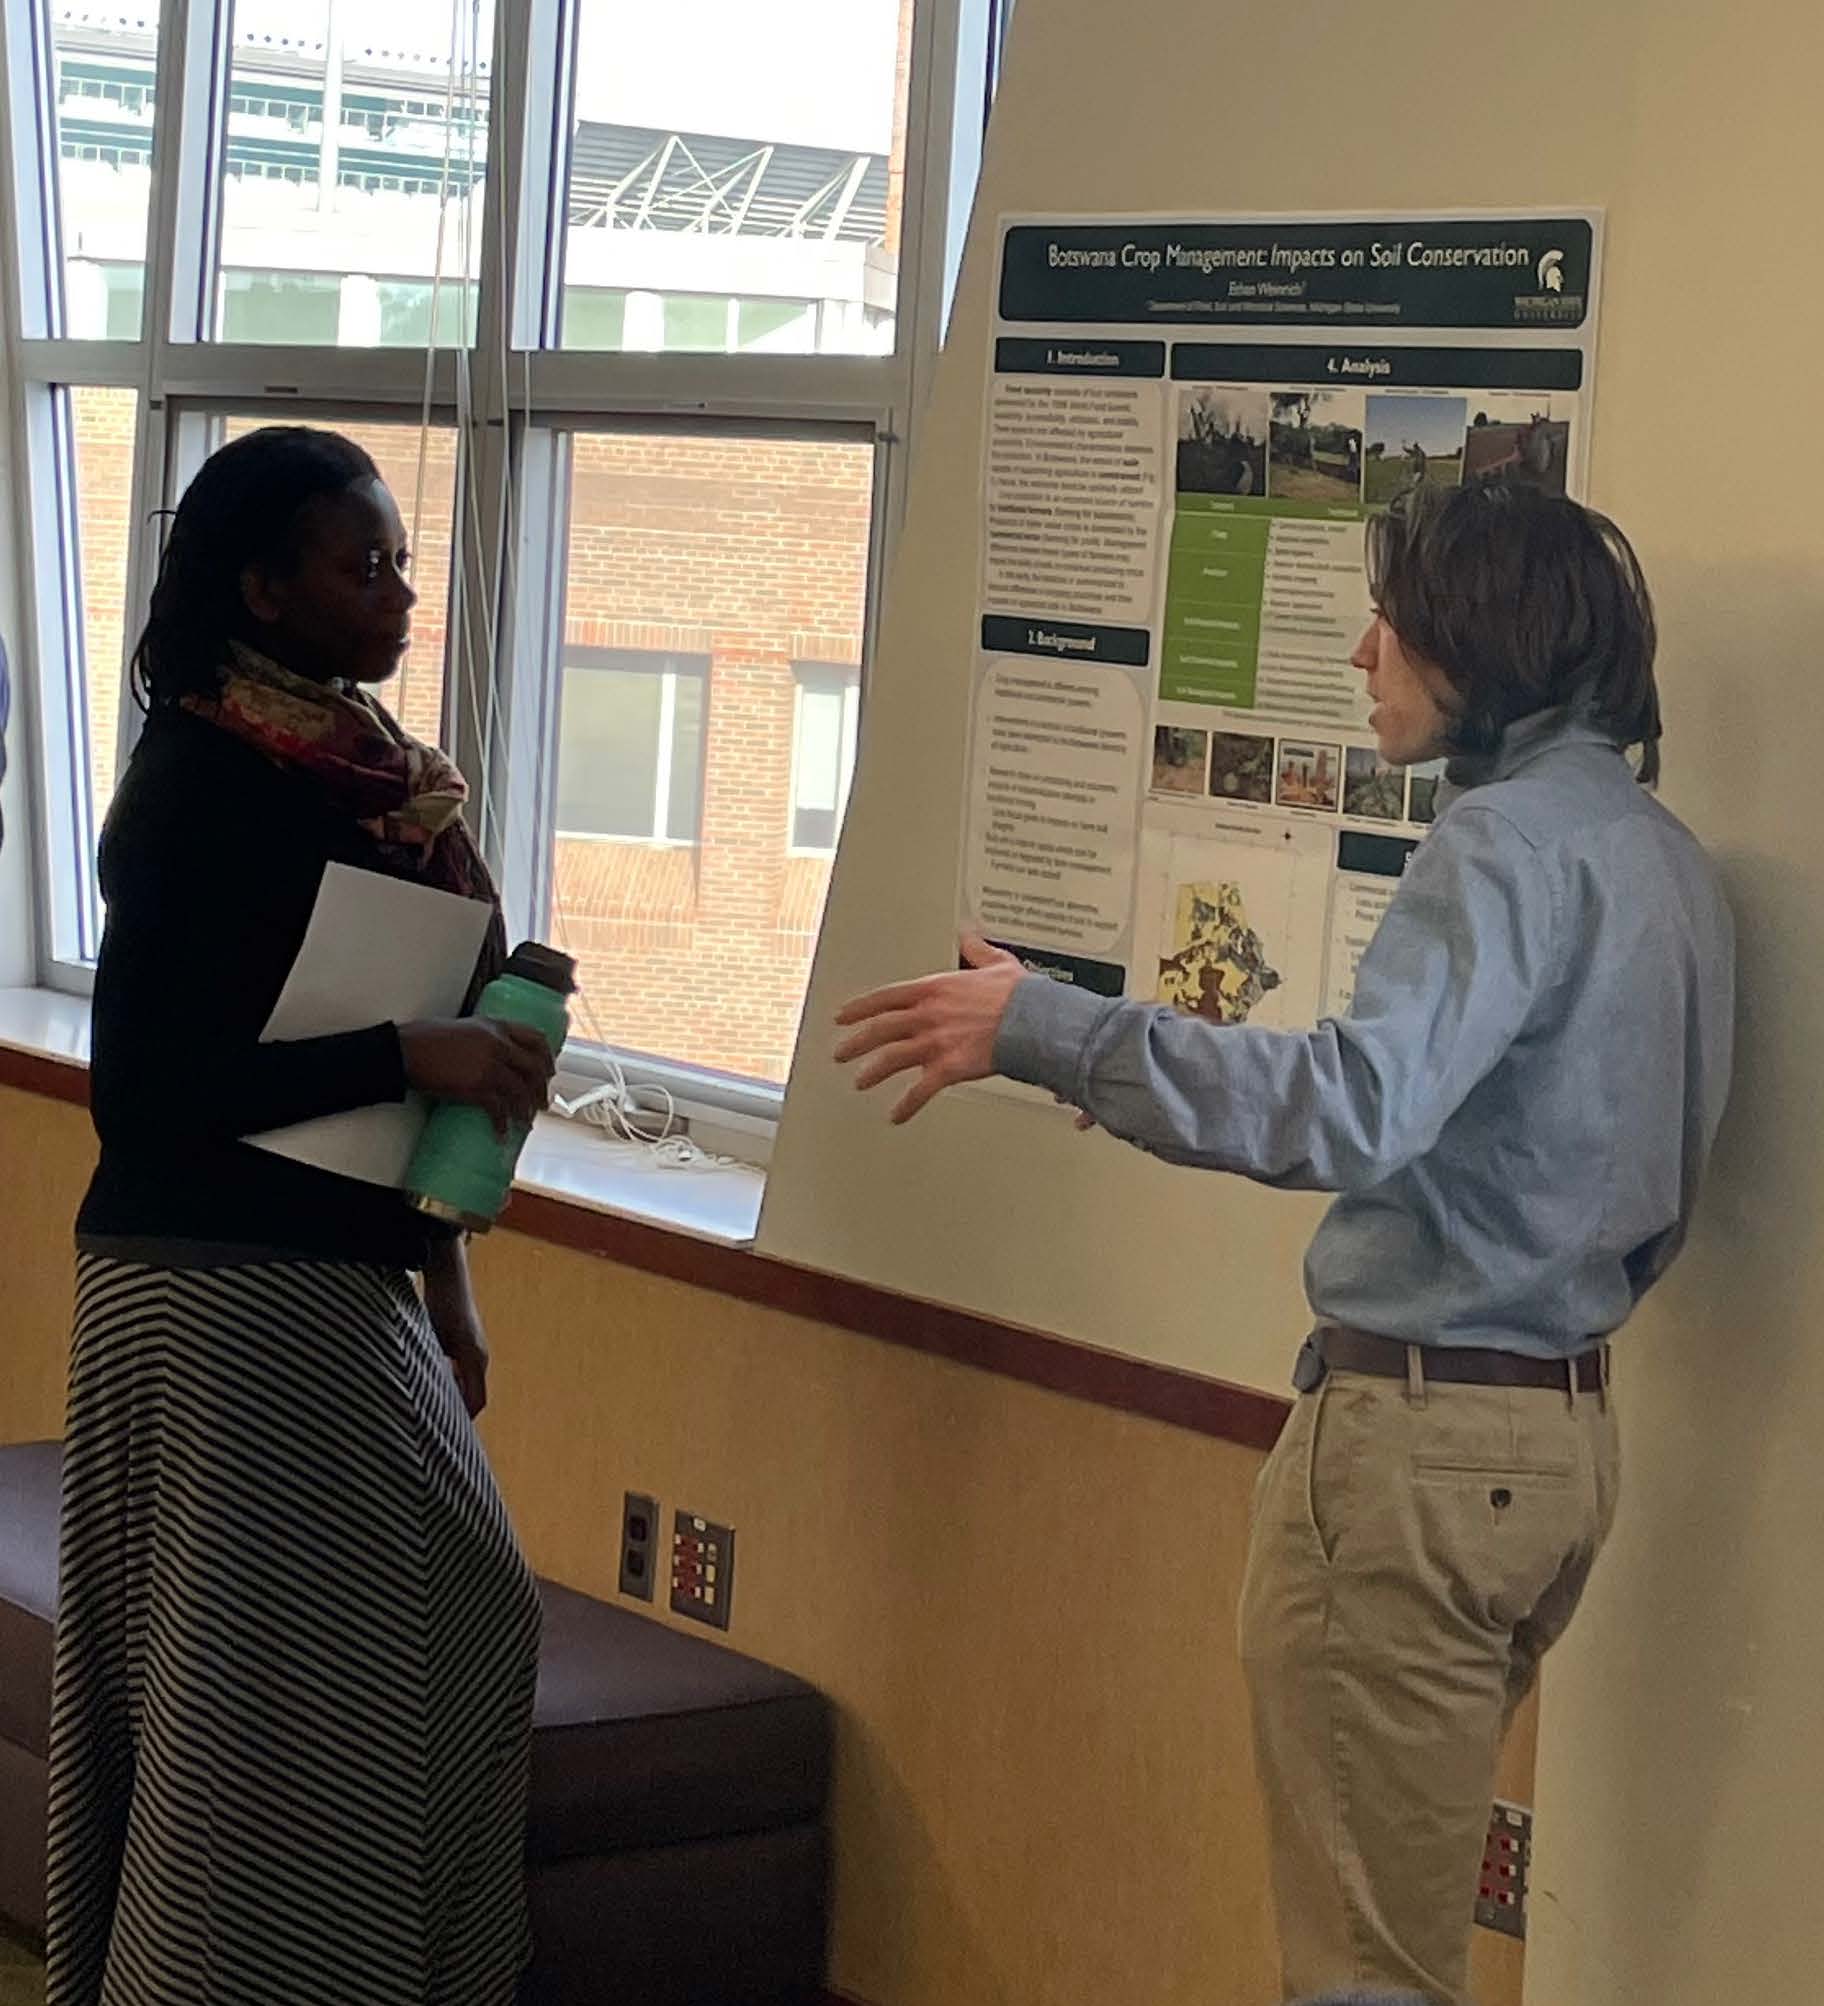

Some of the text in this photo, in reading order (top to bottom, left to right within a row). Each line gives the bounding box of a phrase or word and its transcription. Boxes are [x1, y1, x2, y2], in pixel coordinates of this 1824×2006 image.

[1048, 243, 1116, 267] Botswana
[1121, 243, 1160, 273] Crop
[1270, 243, 1335, 274] Impacts
[1341, 249, 1365, 267] on
[1370, 242, 1402, 267] Soil
[1407, 241, 1529, 267] Conservation
[1341, 357, 1391, 379] Analysis
